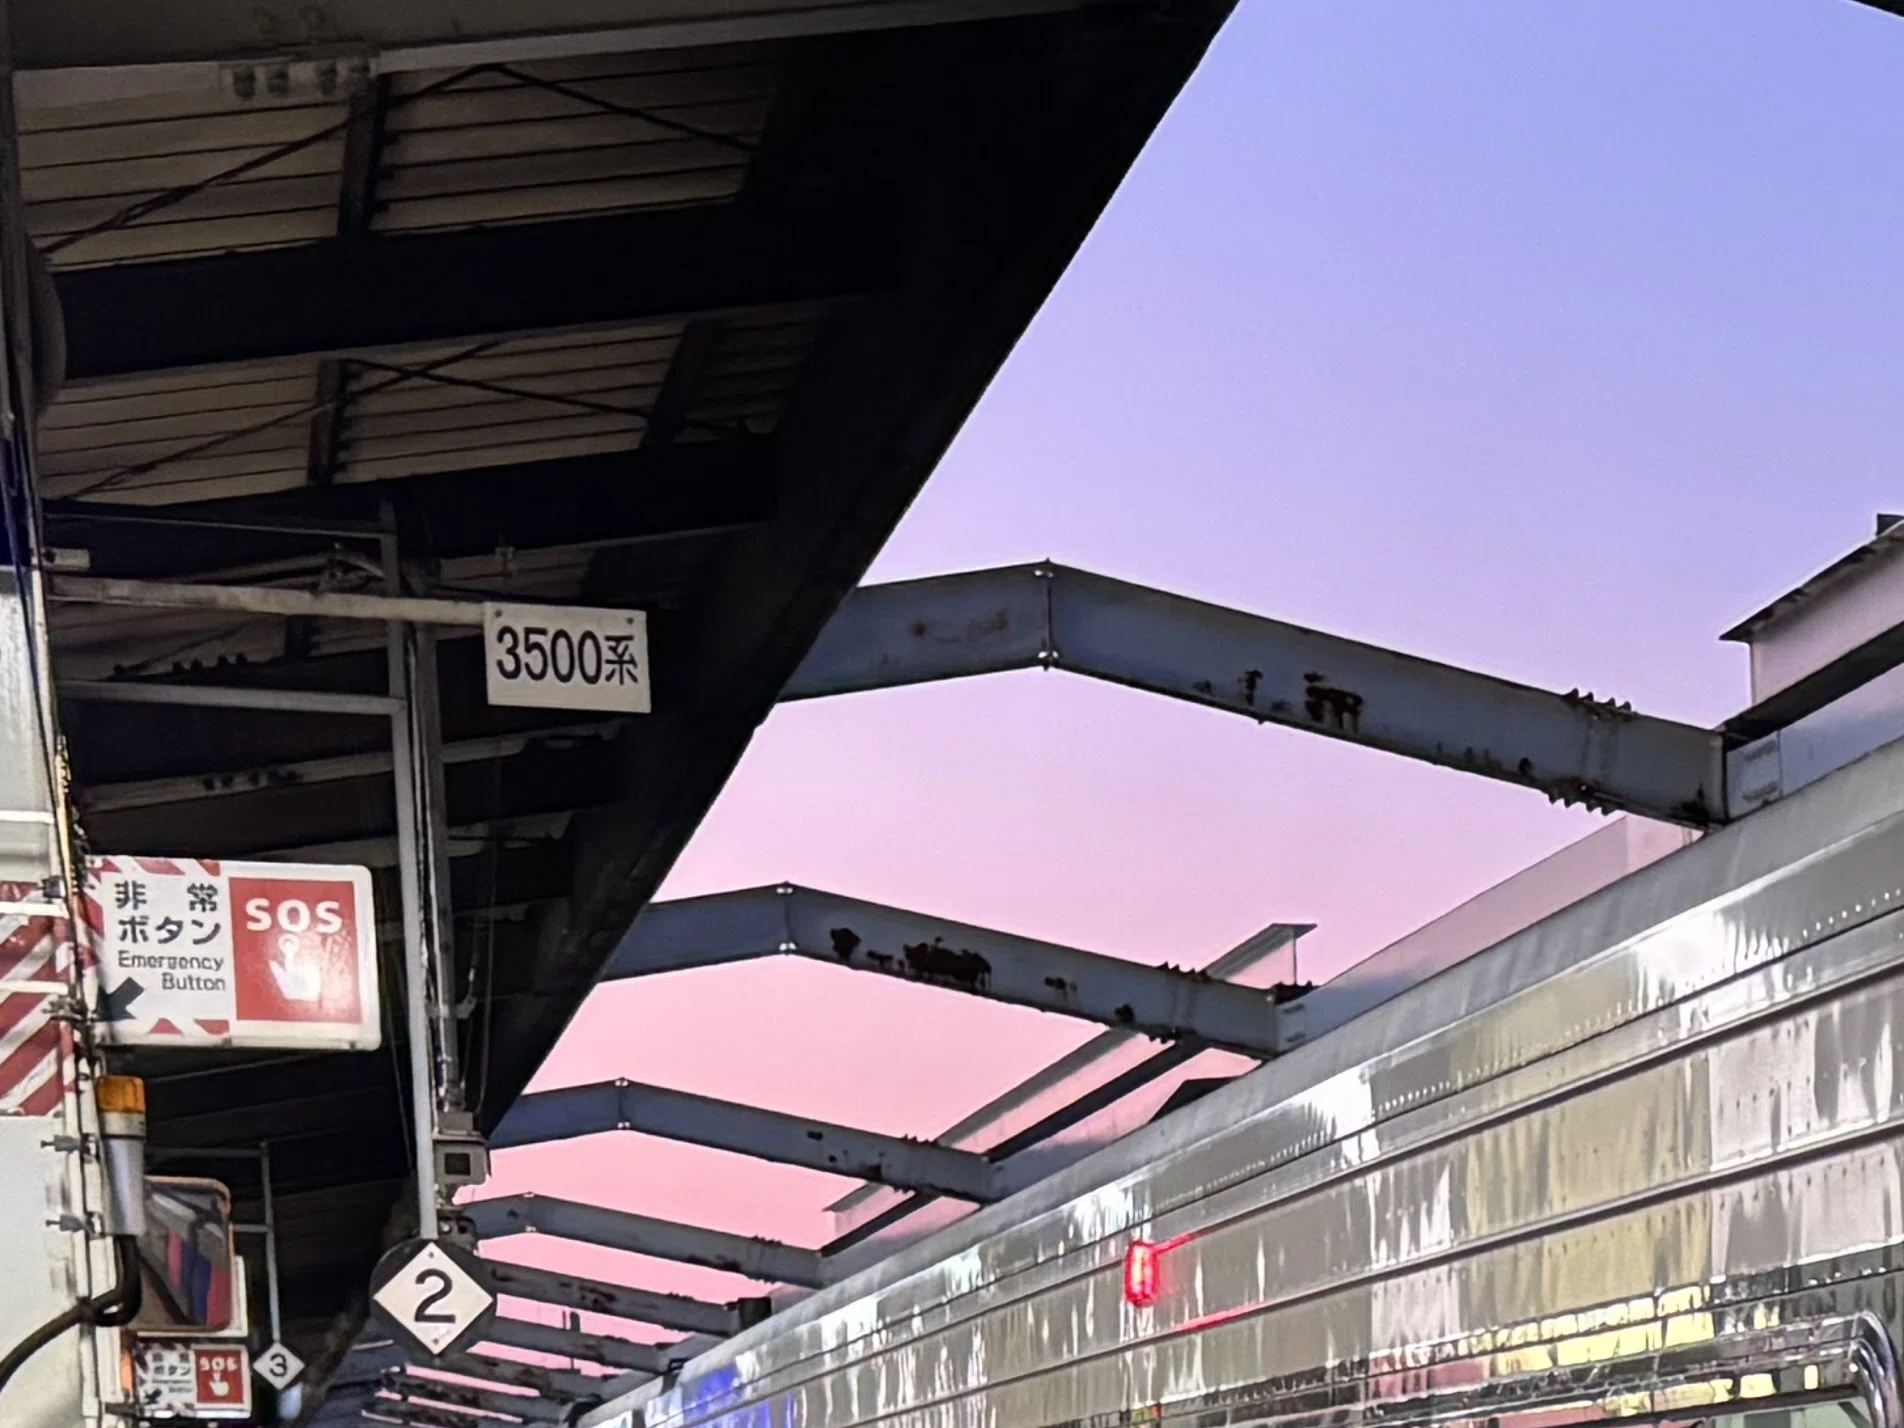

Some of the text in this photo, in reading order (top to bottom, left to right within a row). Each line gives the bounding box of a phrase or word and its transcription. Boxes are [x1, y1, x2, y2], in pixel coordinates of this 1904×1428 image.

[496, 626, 639, 687] 3500系
[118, 915, 223, 946] ボタン
[245, 897, 343, 935] SOS
[118, 950, 224, 971] Emergency
[162, 972, 226, 991] Button
[413, 1268, 456, 1324] 2
[268, 1353, 288, 1377] 3
